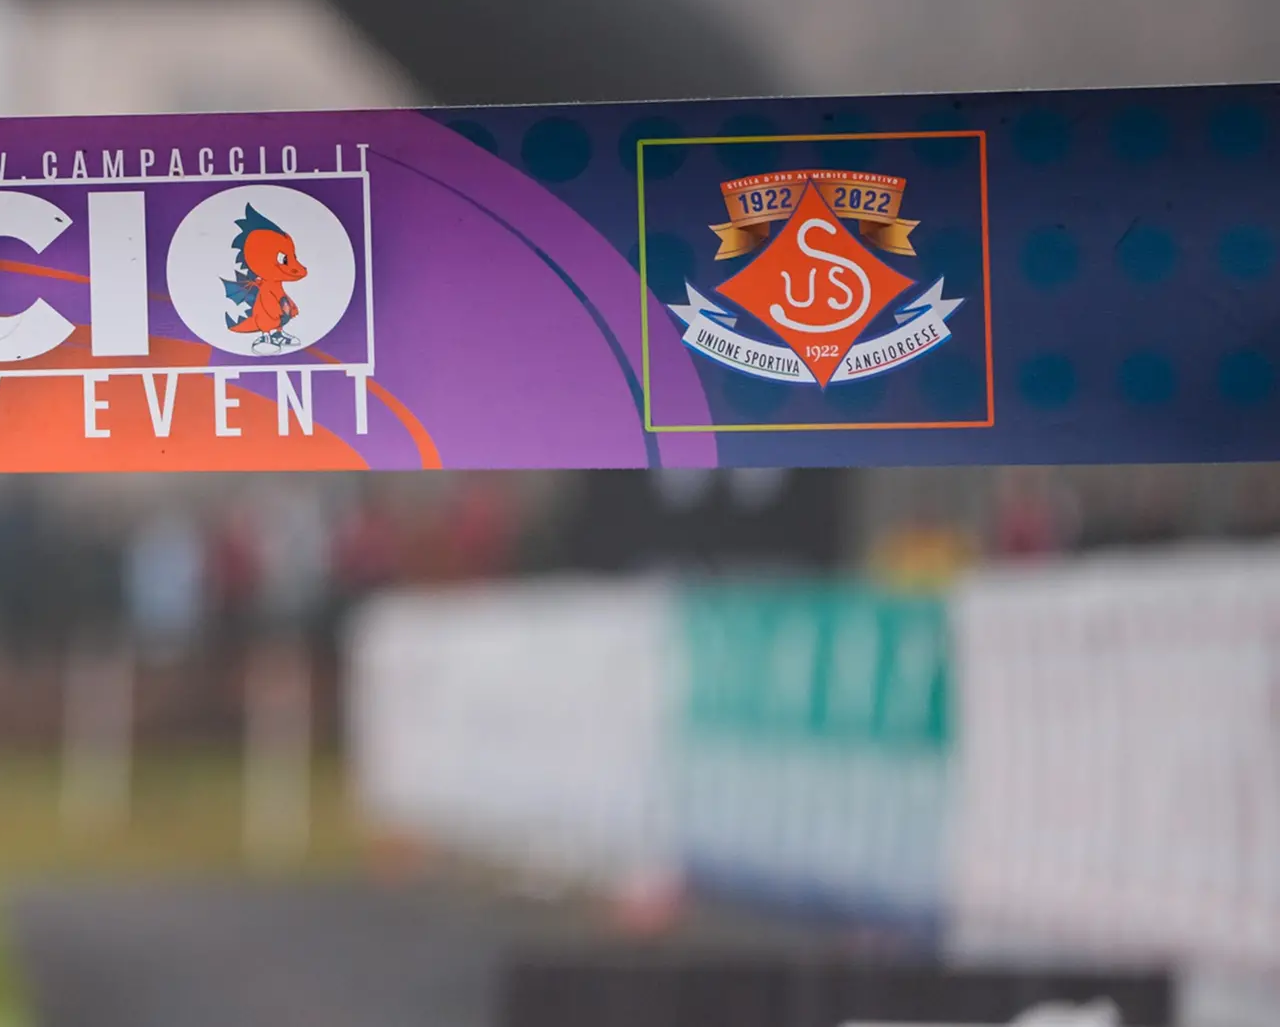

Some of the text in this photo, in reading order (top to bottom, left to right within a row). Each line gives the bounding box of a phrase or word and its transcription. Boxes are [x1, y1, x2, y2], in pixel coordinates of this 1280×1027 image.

[726, 177, 760, 190] STELLA
[812, 172, 848, 180] MERITO
[852, 173, 899, 185] SPORTIVO
[738, 187, 891, 214] 1922 2022
[696, 323, 939, 374] UNIONE SPORTIVA SANGIORGESE
[805, 344, 840, 362] 1922
[82, 369, 375, 438] EVENT
